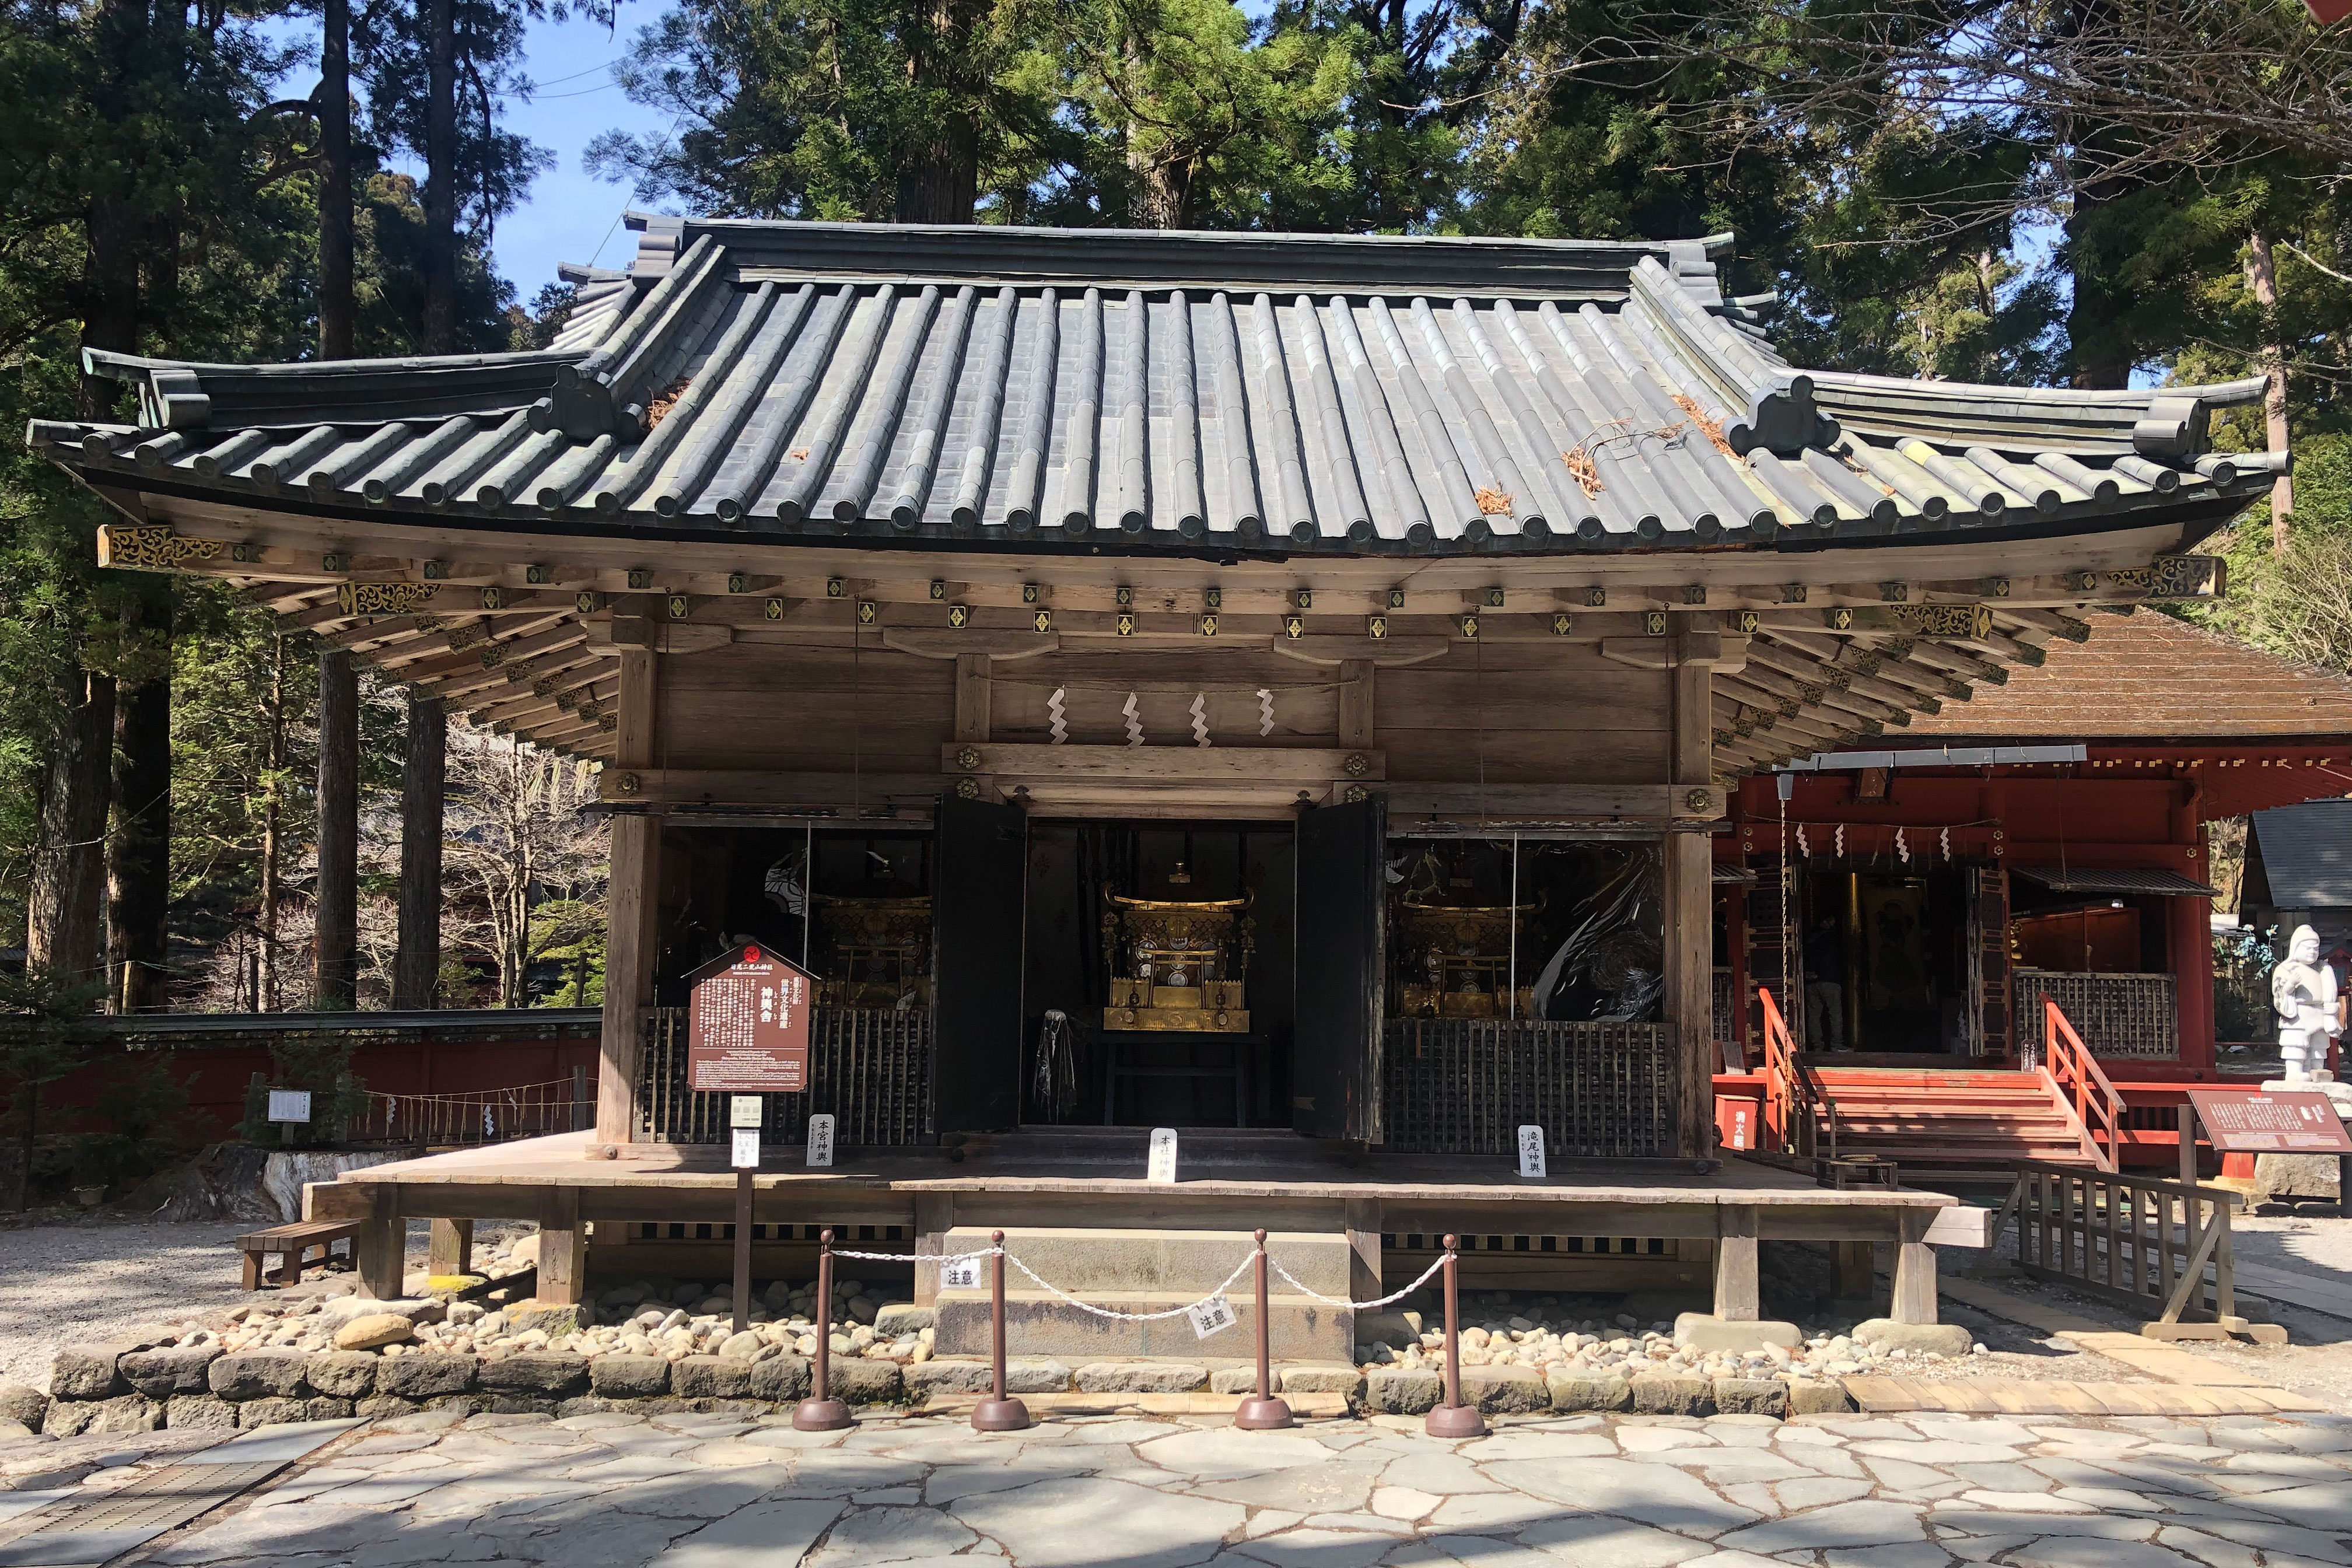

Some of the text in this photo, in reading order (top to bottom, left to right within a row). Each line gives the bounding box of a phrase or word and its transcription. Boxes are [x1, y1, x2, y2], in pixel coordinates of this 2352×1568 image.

[779, 978, 789, 1029] 世界文化遺産
[816, 1119, 829, 1162] 本宮神輿
[1734, 1111, 1746, 1147] 消火器
[1158, 1135, 1171, 1178] 本社神輿
[1527, 1131, 1540, 1172] 滝尾神輿
[948, 1269, 972, 1285] 注意
[1199, 1308, 1227, 1331] 注意
